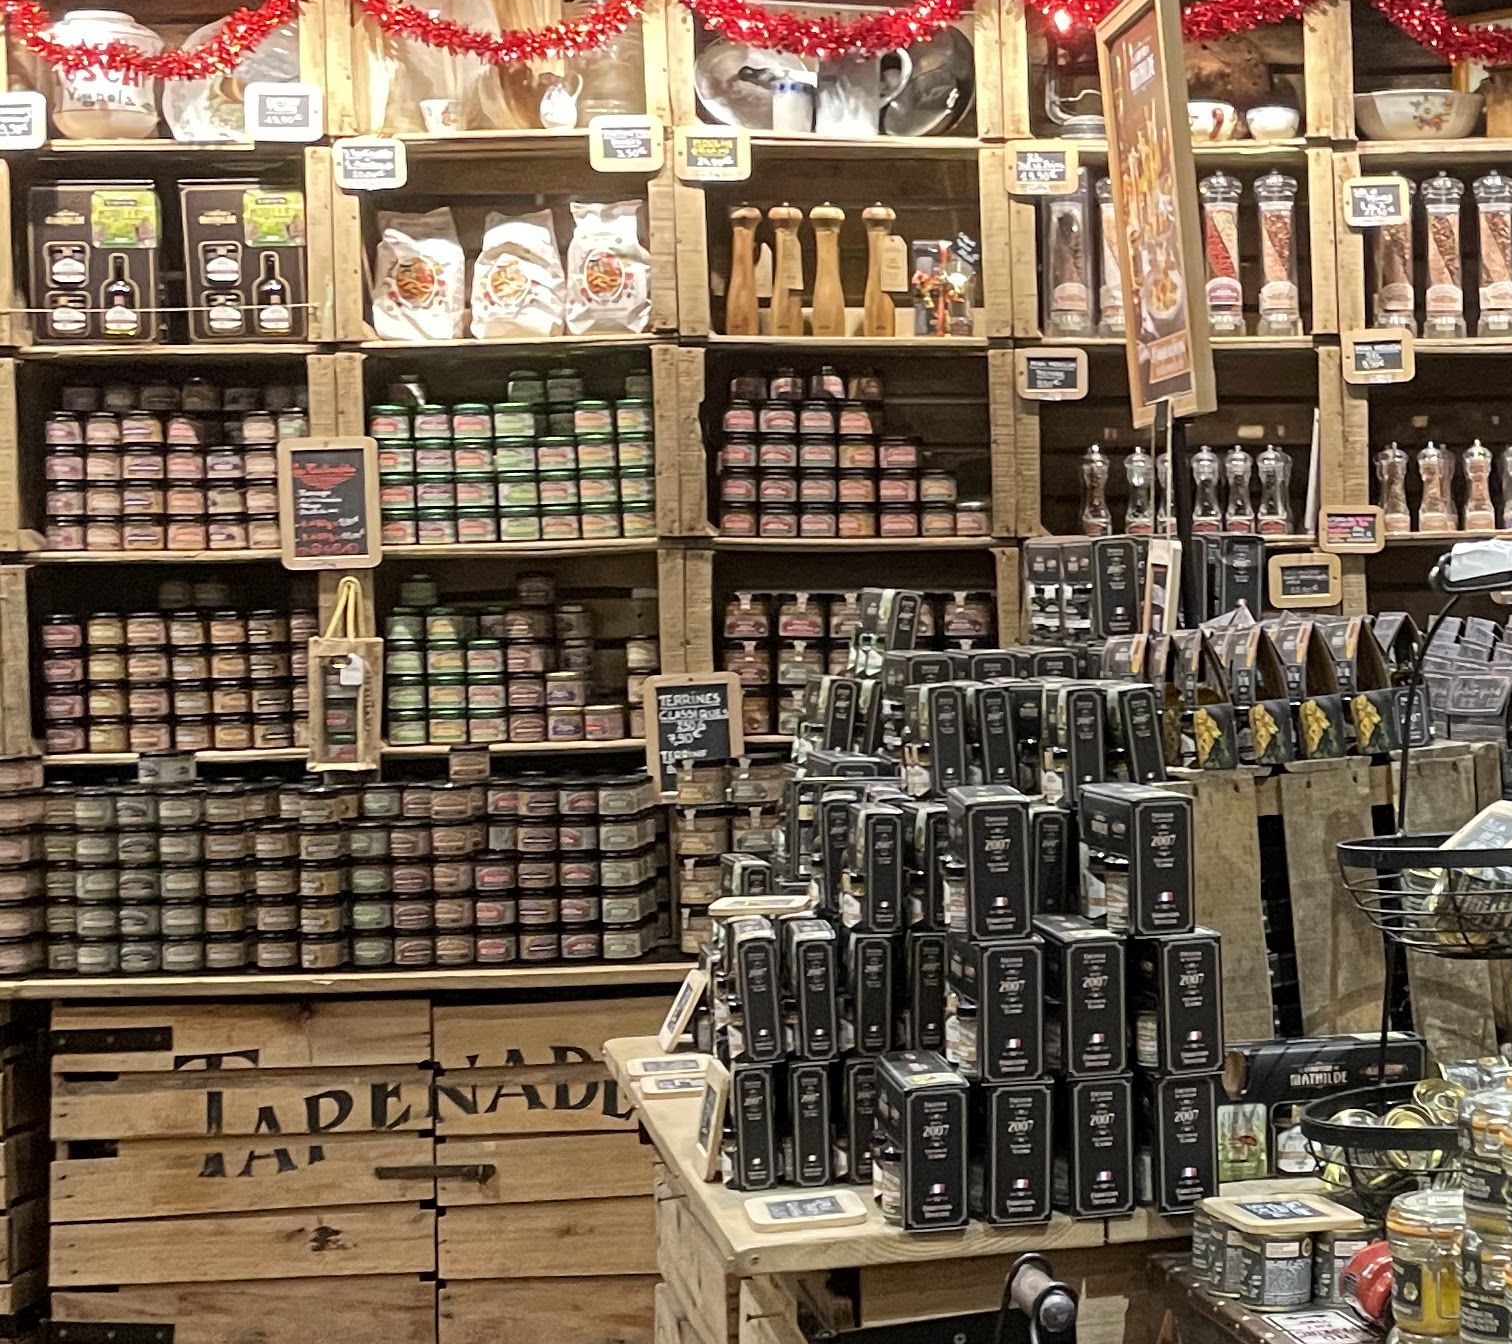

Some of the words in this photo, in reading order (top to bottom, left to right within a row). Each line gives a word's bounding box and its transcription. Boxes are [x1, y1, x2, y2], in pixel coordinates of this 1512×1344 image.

[658, 692, 721, 707] TERRINES
[1289, 1071, 1349, 1087] MATHILDE
[1089, 1113, 1115, 1127] 2007
[1174, 1109, 1200, 1124] 2007
[922, 1124, 951, 1138] 2007
[1008, 1119, 1035, 1133] 2007
